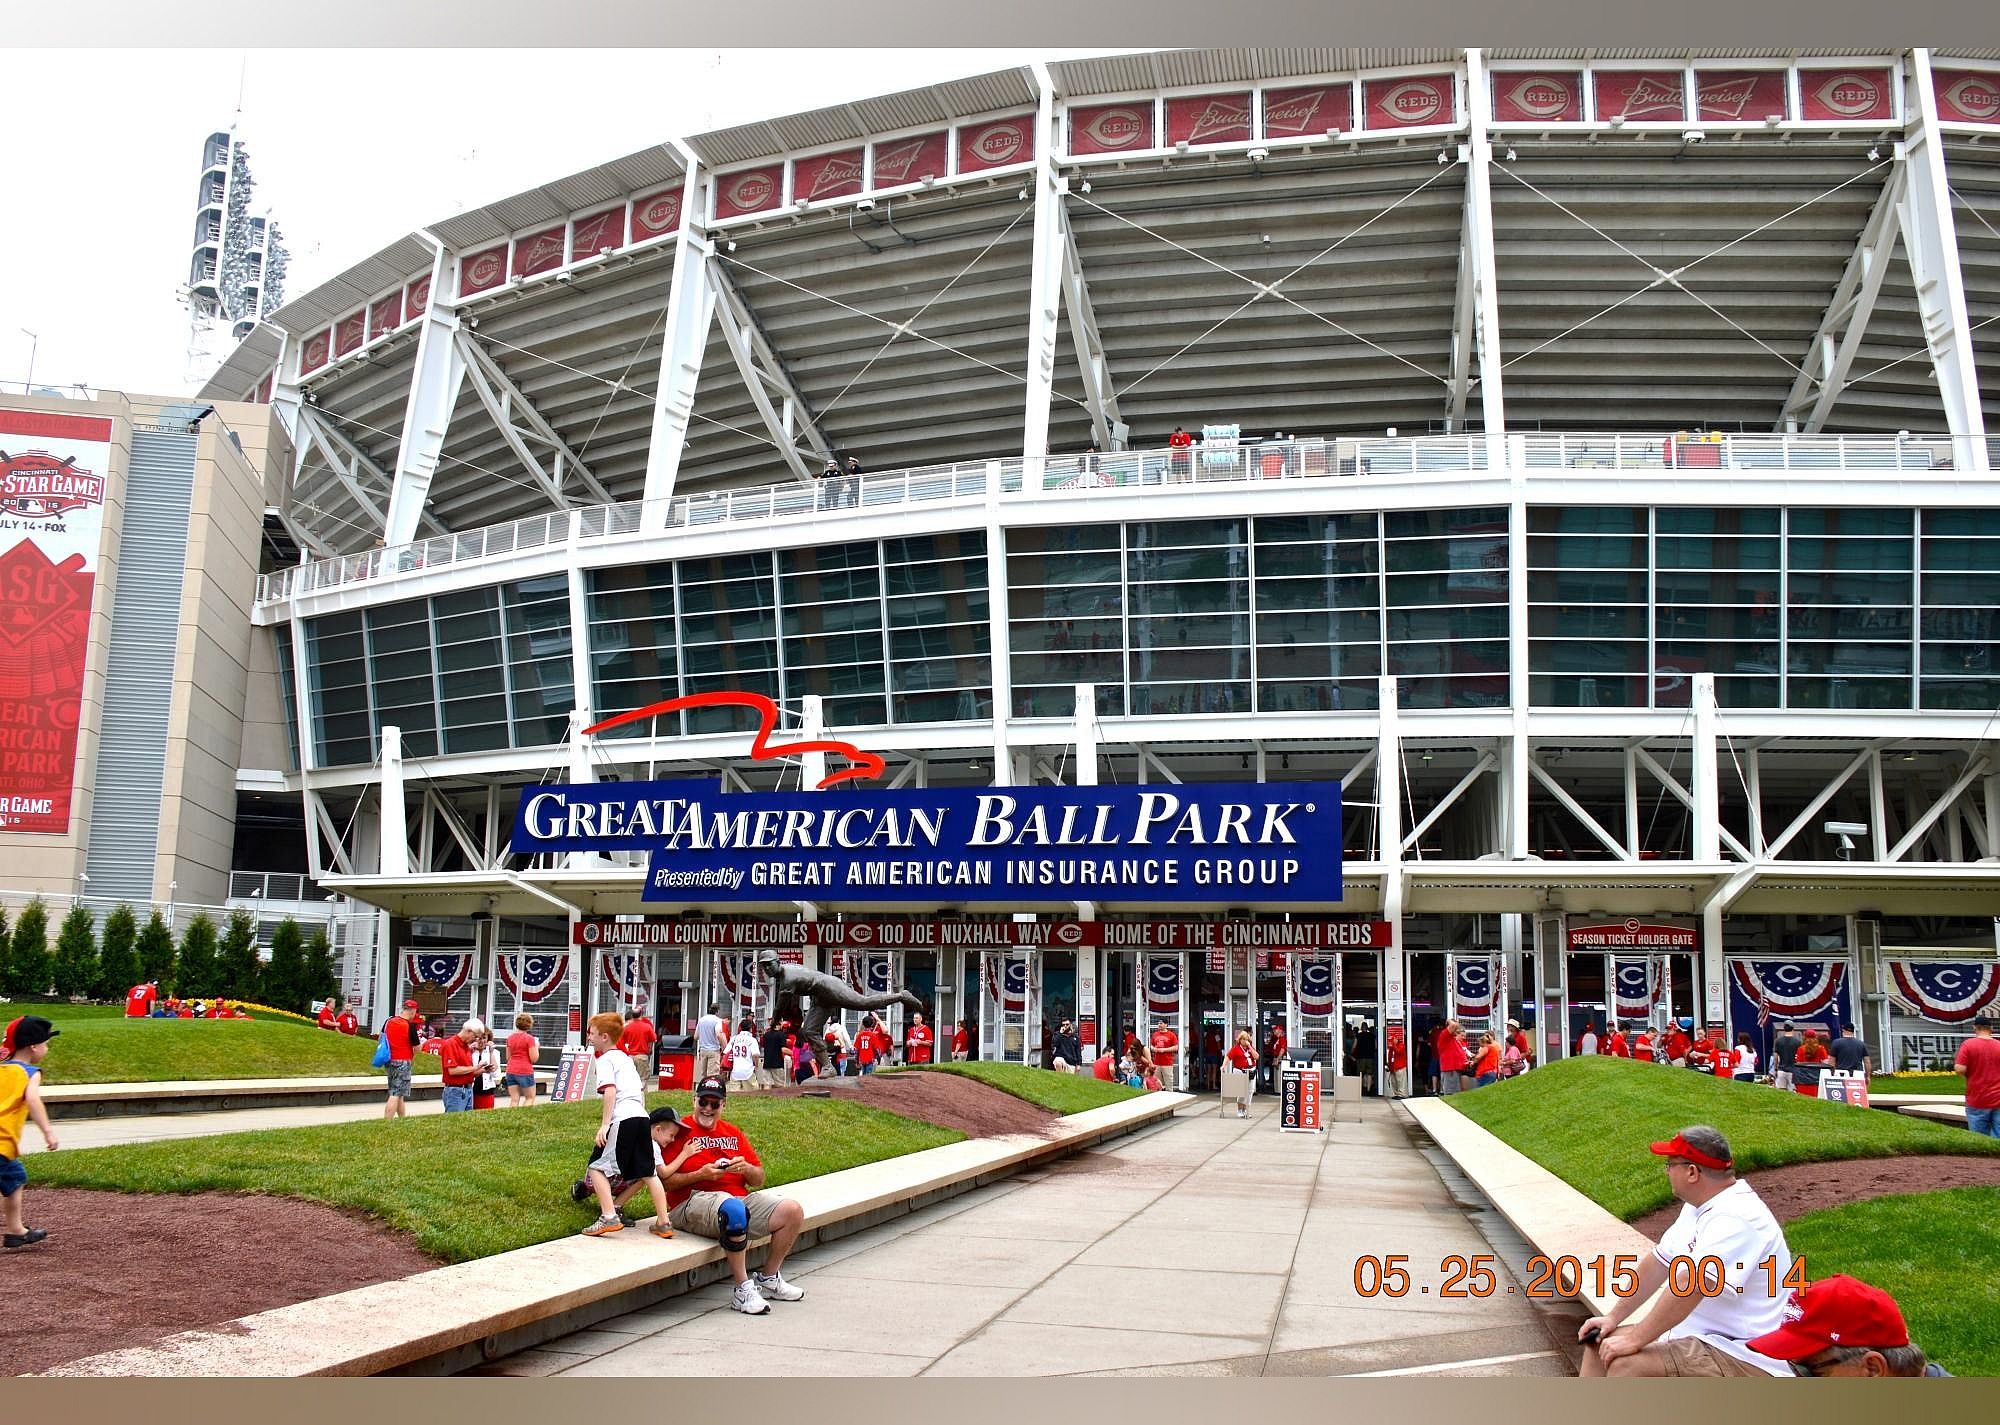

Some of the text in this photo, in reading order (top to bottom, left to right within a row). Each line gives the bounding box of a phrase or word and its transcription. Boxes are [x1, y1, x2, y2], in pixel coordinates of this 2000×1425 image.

[1395, 94, 1440, 109] REDS
[1525, 90, 1568, 103] REDS
[1833, 89, 1876, 102] REDS
[1101, 119, 1142, 134] REDS
[984, 134, 1021, 149] REDS
[738, 182, 773, 198] REDS
[650, 204, 678, 219] REDS
[4, 474, 99, 497] STAR GAME
[23, 521, 36, 531] 14
[44, 522, 67, 533] FOX
[3, 751, 62, 774] PARK
[11, 796, 52, 814] GAME
[524, 792, 686, 839] GREAT
[664, 801, 950, 850] AMERICAN
[965, 794, 1120, 846] BALL
[654, 859, 1299, 890] Presented by GREAT AMERICAN INSURANCE GROUP
[603, 923, 845, 944] HAMILTON COUNTY WELCOMES YOU
[878, 923, 1052, 944] 100 JOE NUXHALL WAY
[1104, 923, 1372, 945] HOME OF THE CINCINNATI REDS
[1572, 934, 1693, 945] SEASON TICKET HOLDER GATE
[734, 1046, 747, 1057] 39
